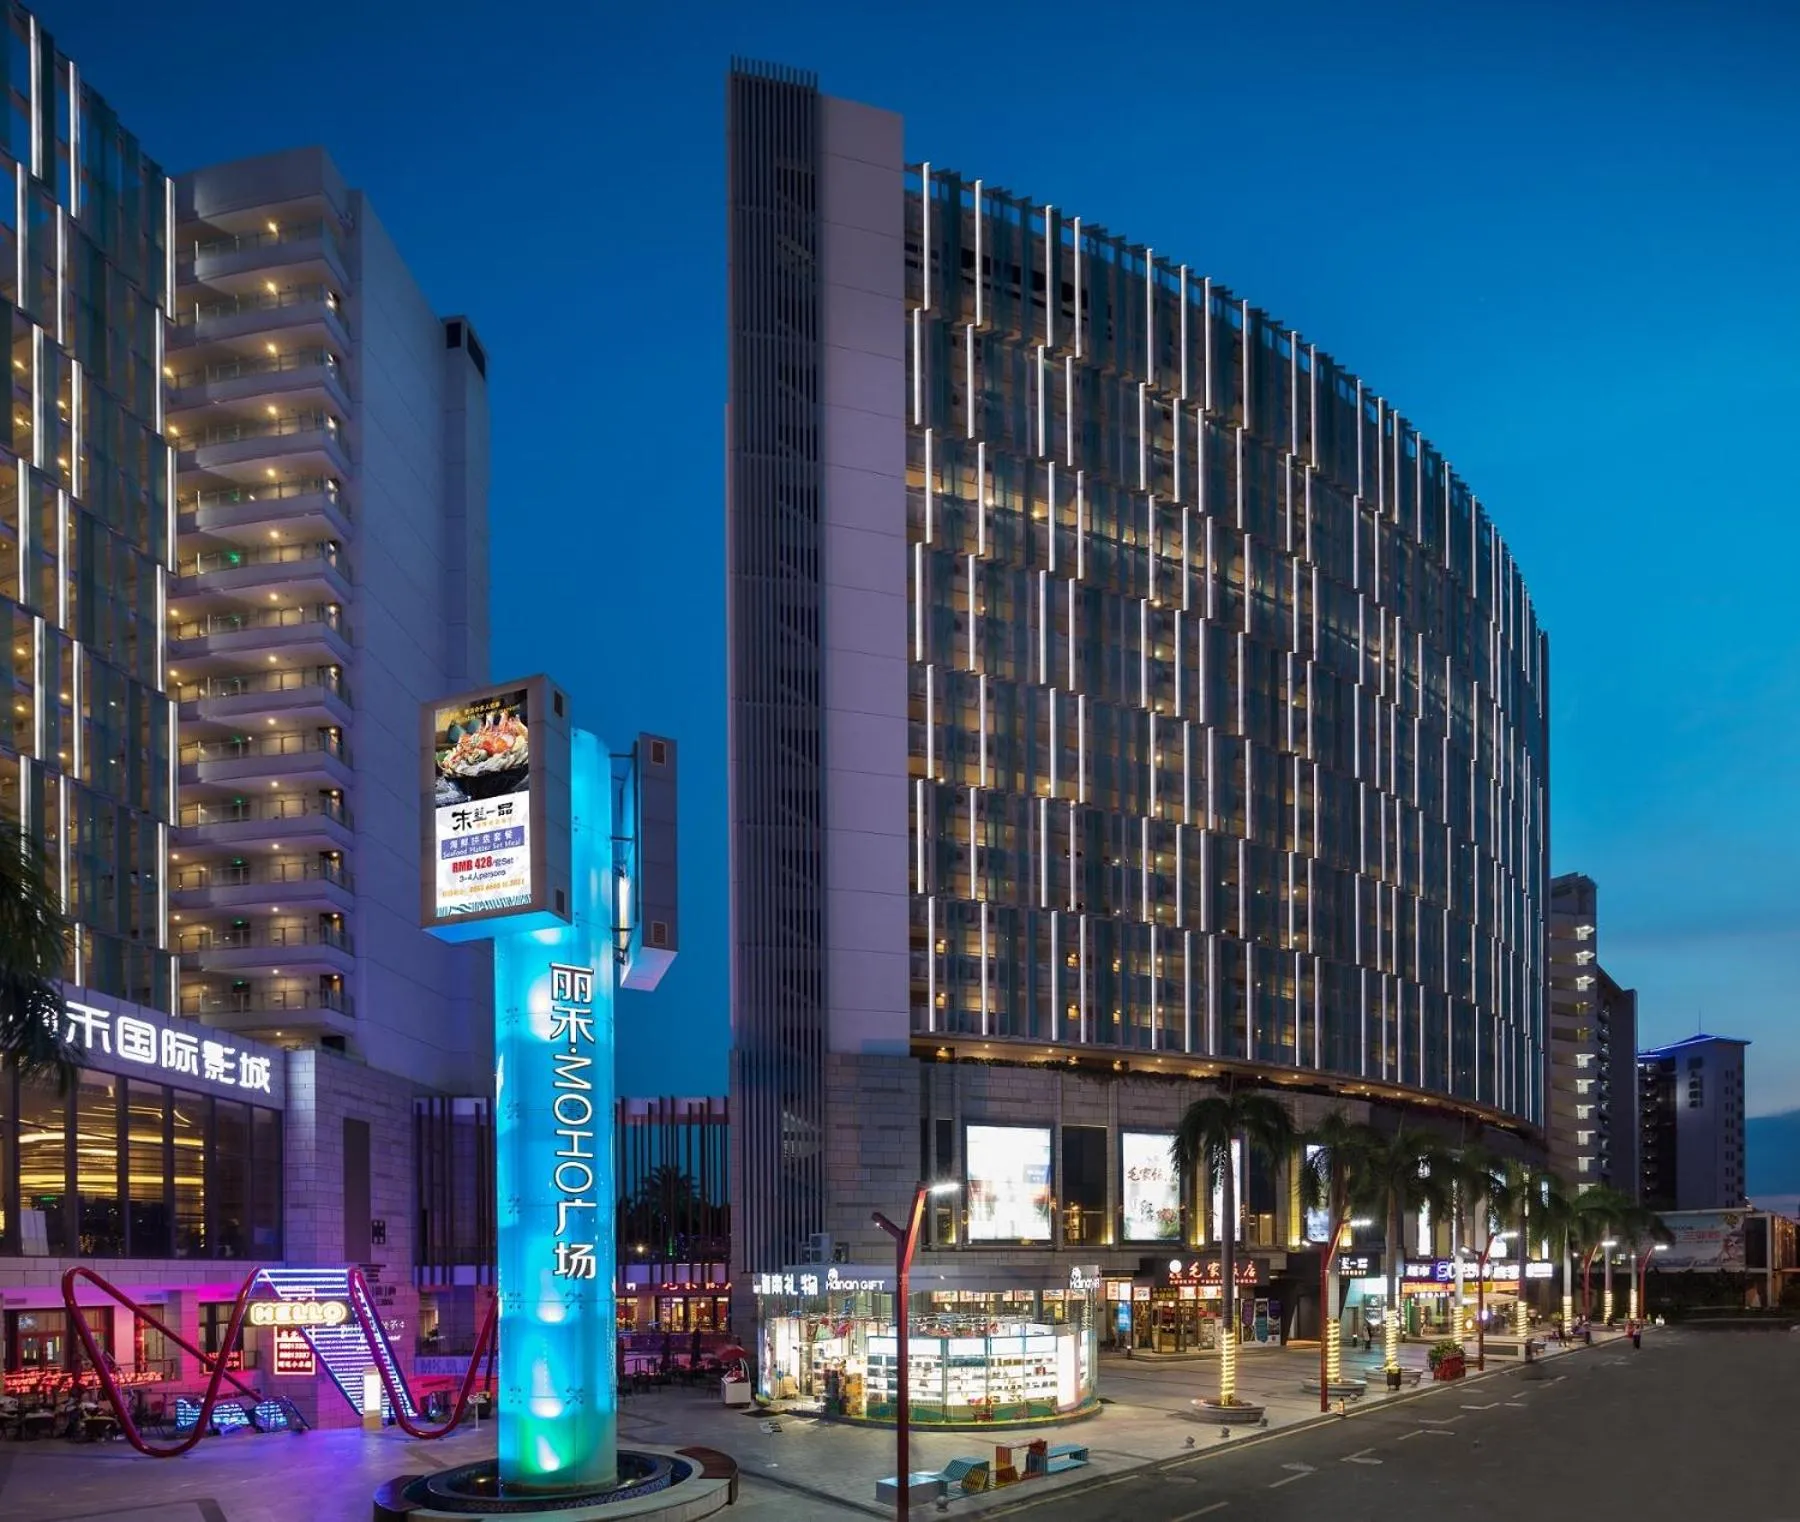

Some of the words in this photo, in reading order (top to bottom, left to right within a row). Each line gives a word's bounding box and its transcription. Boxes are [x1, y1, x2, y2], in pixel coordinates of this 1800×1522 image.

[451, 860, 473, 873] RMB
[474, 856, 493, 869] 428
[860, 1280, 885, 1291] GIFT
[251, 1302, 347, 1326] HELLO
